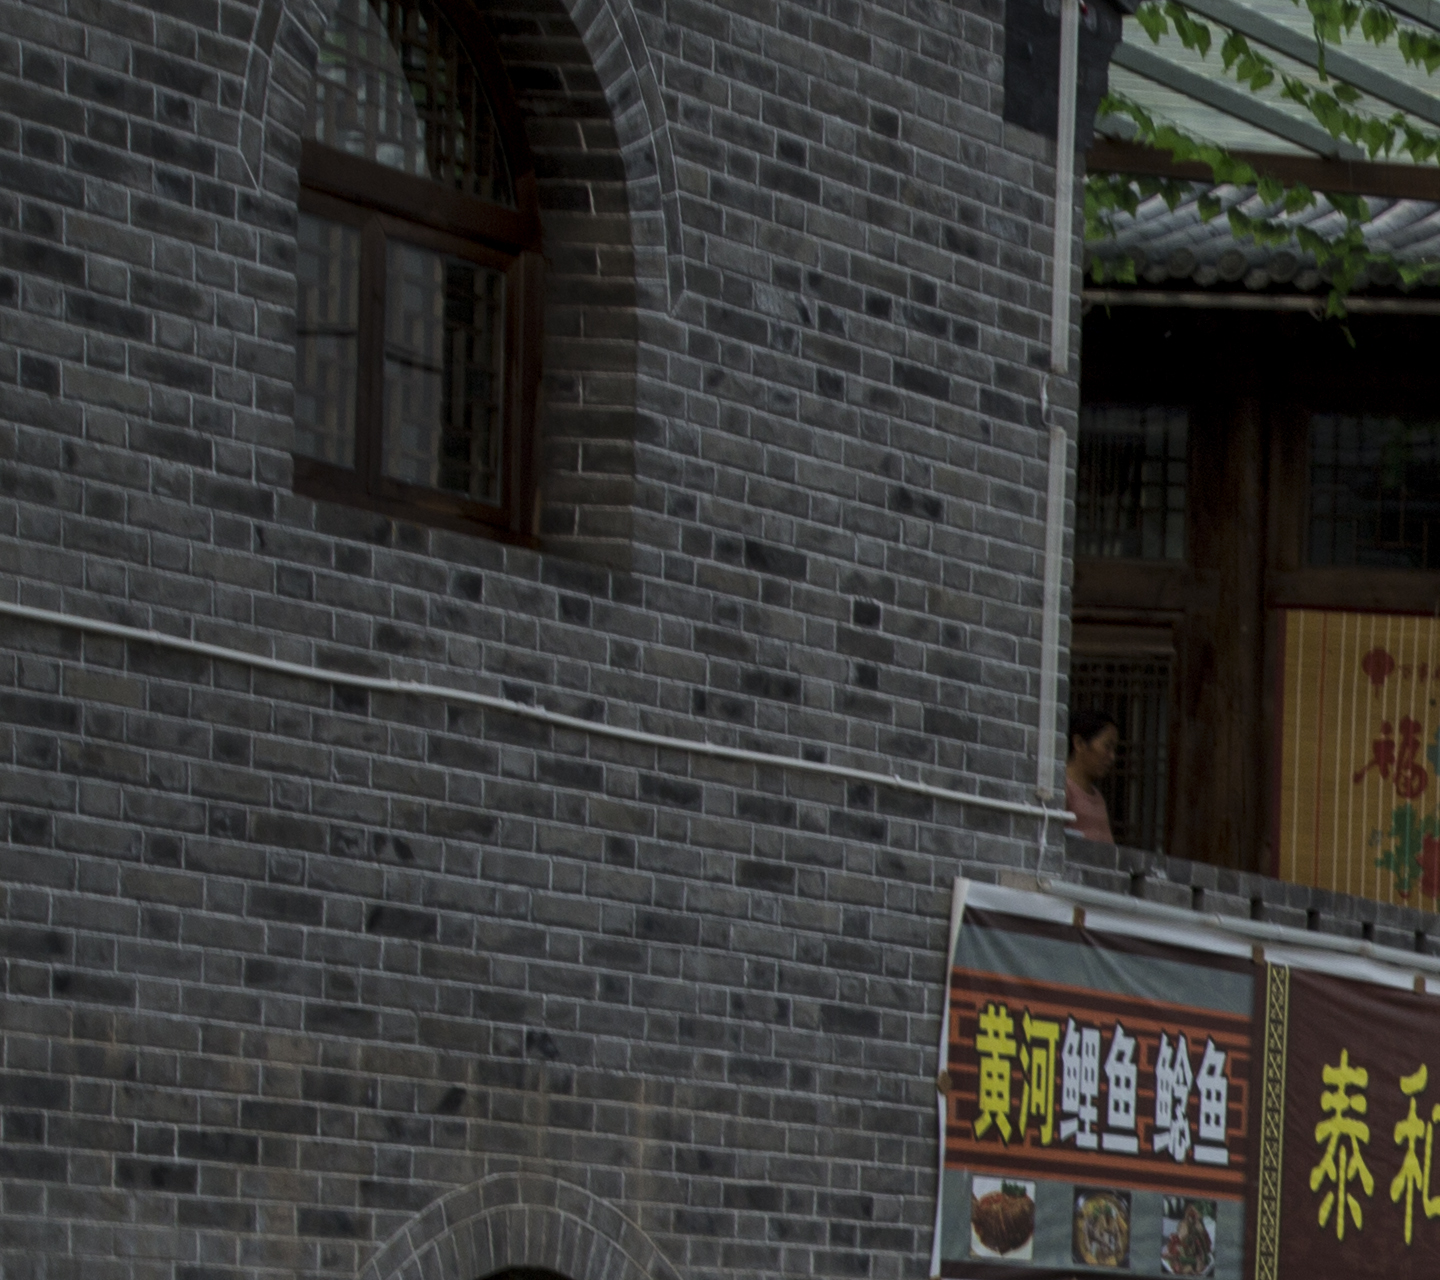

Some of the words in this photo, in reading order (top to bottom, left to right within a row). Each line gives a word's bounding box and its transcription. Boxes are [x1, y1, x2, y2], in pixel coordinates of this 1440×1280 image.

[1353, 714, 1429, 800] 福
[971, 1002, 1139, 1154] 黄河鲤鱼
